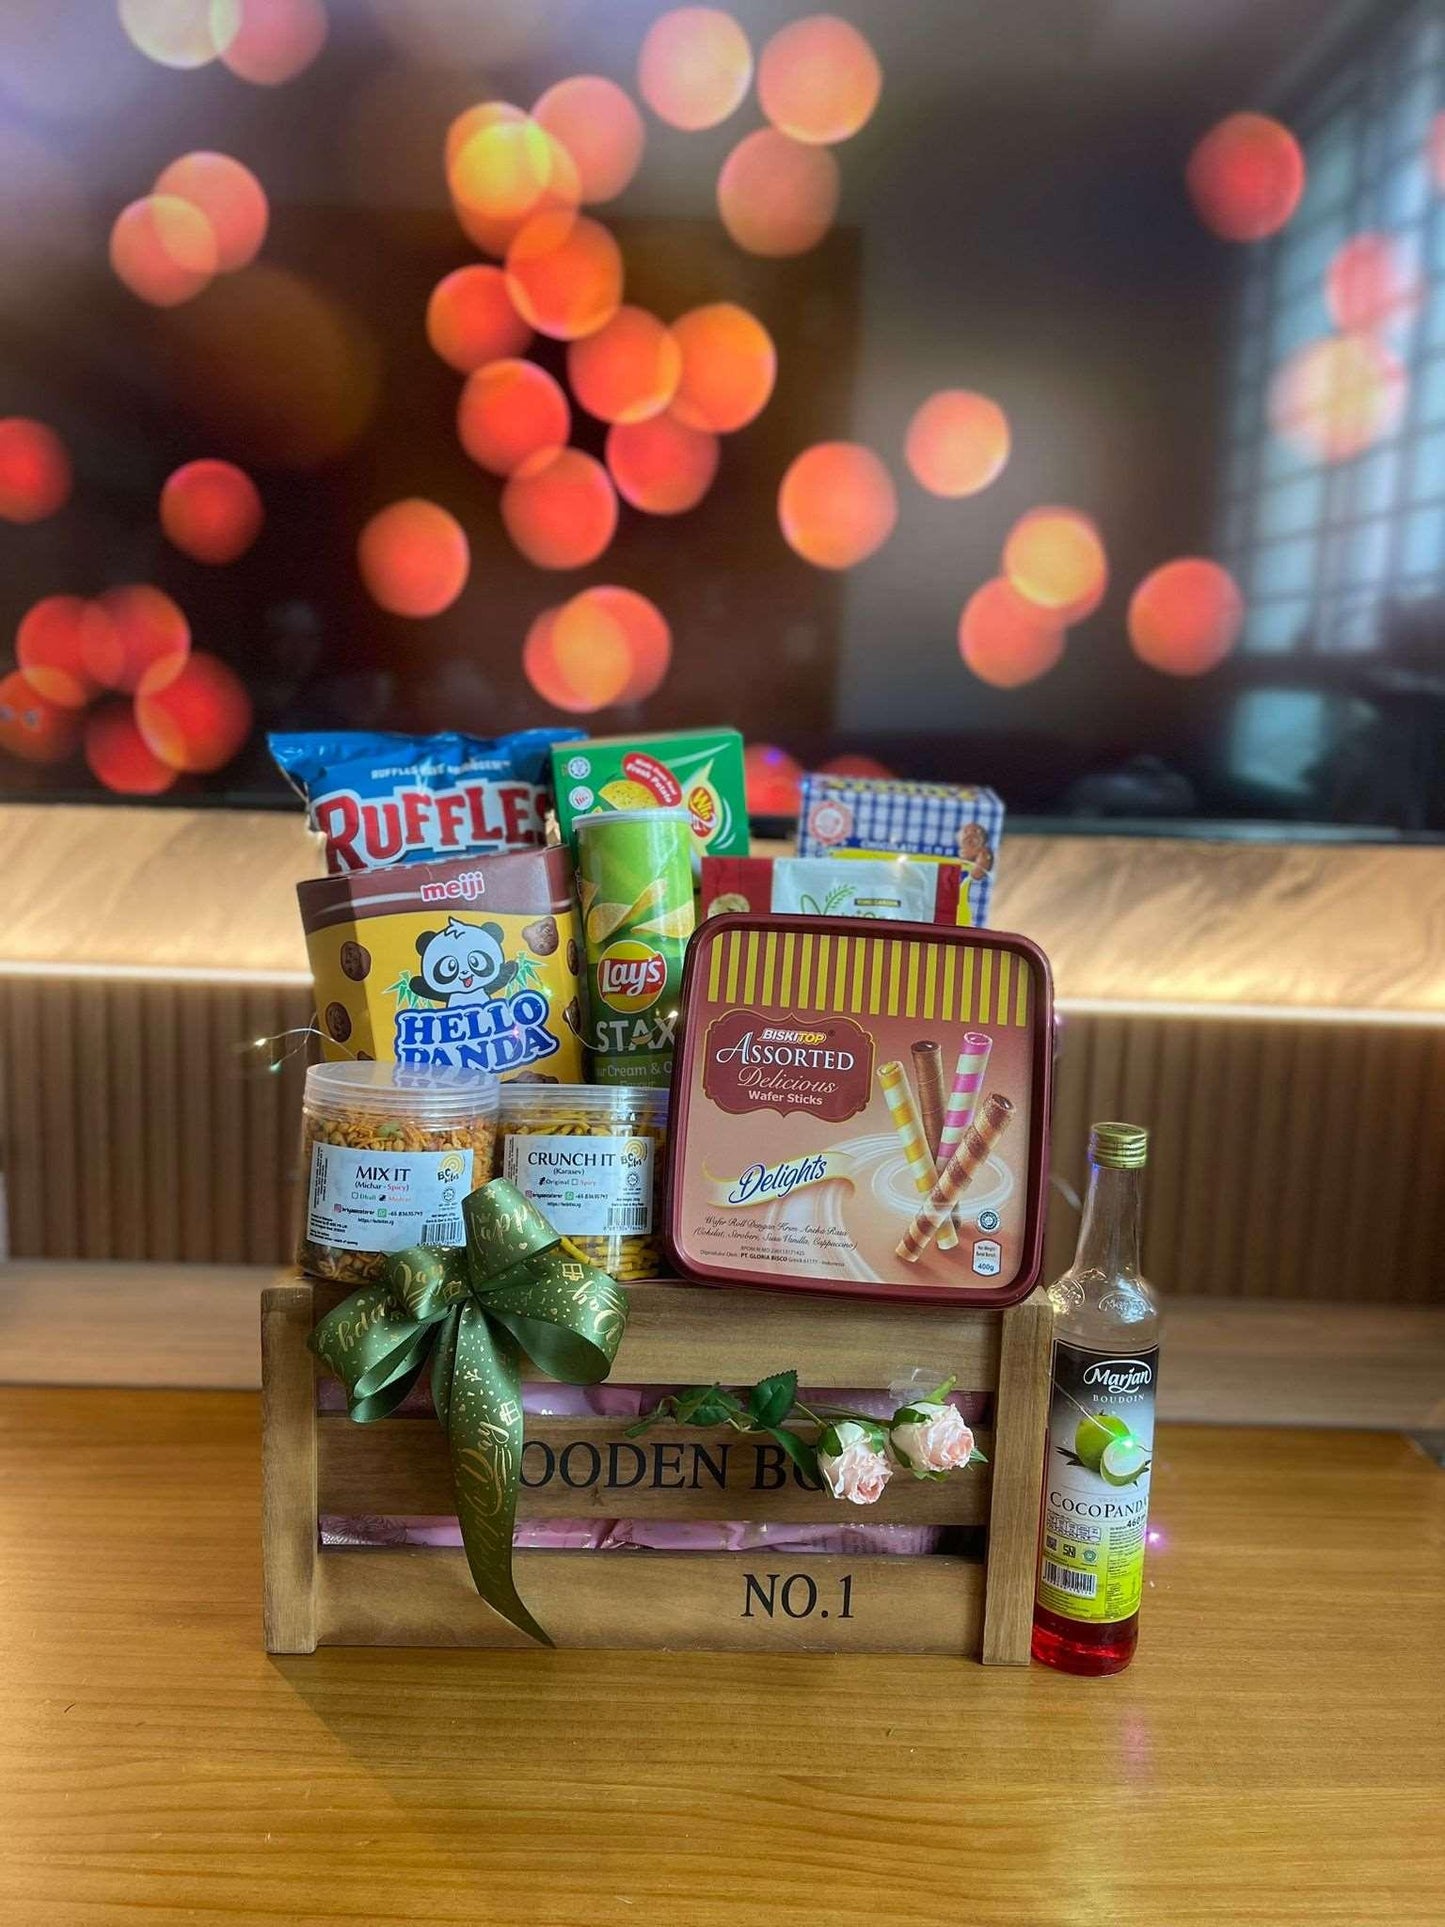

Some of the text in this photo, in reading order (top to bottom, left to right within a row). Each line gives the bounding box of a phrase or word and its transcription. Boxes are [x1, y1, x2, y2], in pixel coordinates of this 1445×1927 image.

[422, 873, 484, 901] meiji
[602, 958, 662, 996] Lay's
[402, 996, 543, 1045] HELLO
[596, 1017, 677, 1053] STAX
[762, 1028, 826, 1044] BISKITOP
[608, 1064, 647, 1078] Cream
[651, 1063, 660, 1075] &
[737, 1066, 838, 1094] Delicious
[749, 1090, 823, 1105] Wafer Sticks
[528, 1151, 616, 1166] CRUNCH IT
[356, 1166, 411, 1182] MIX IT
[729, 1155, 827, 1203] Delights
[1083, 1359, 1152, 1394] Marjan
[1093, 1394, 1144, 1404] BOUDOIN
[519, 1441, 733, 1489] OODEN
[741, 1573, 854, 1618] NO.1
